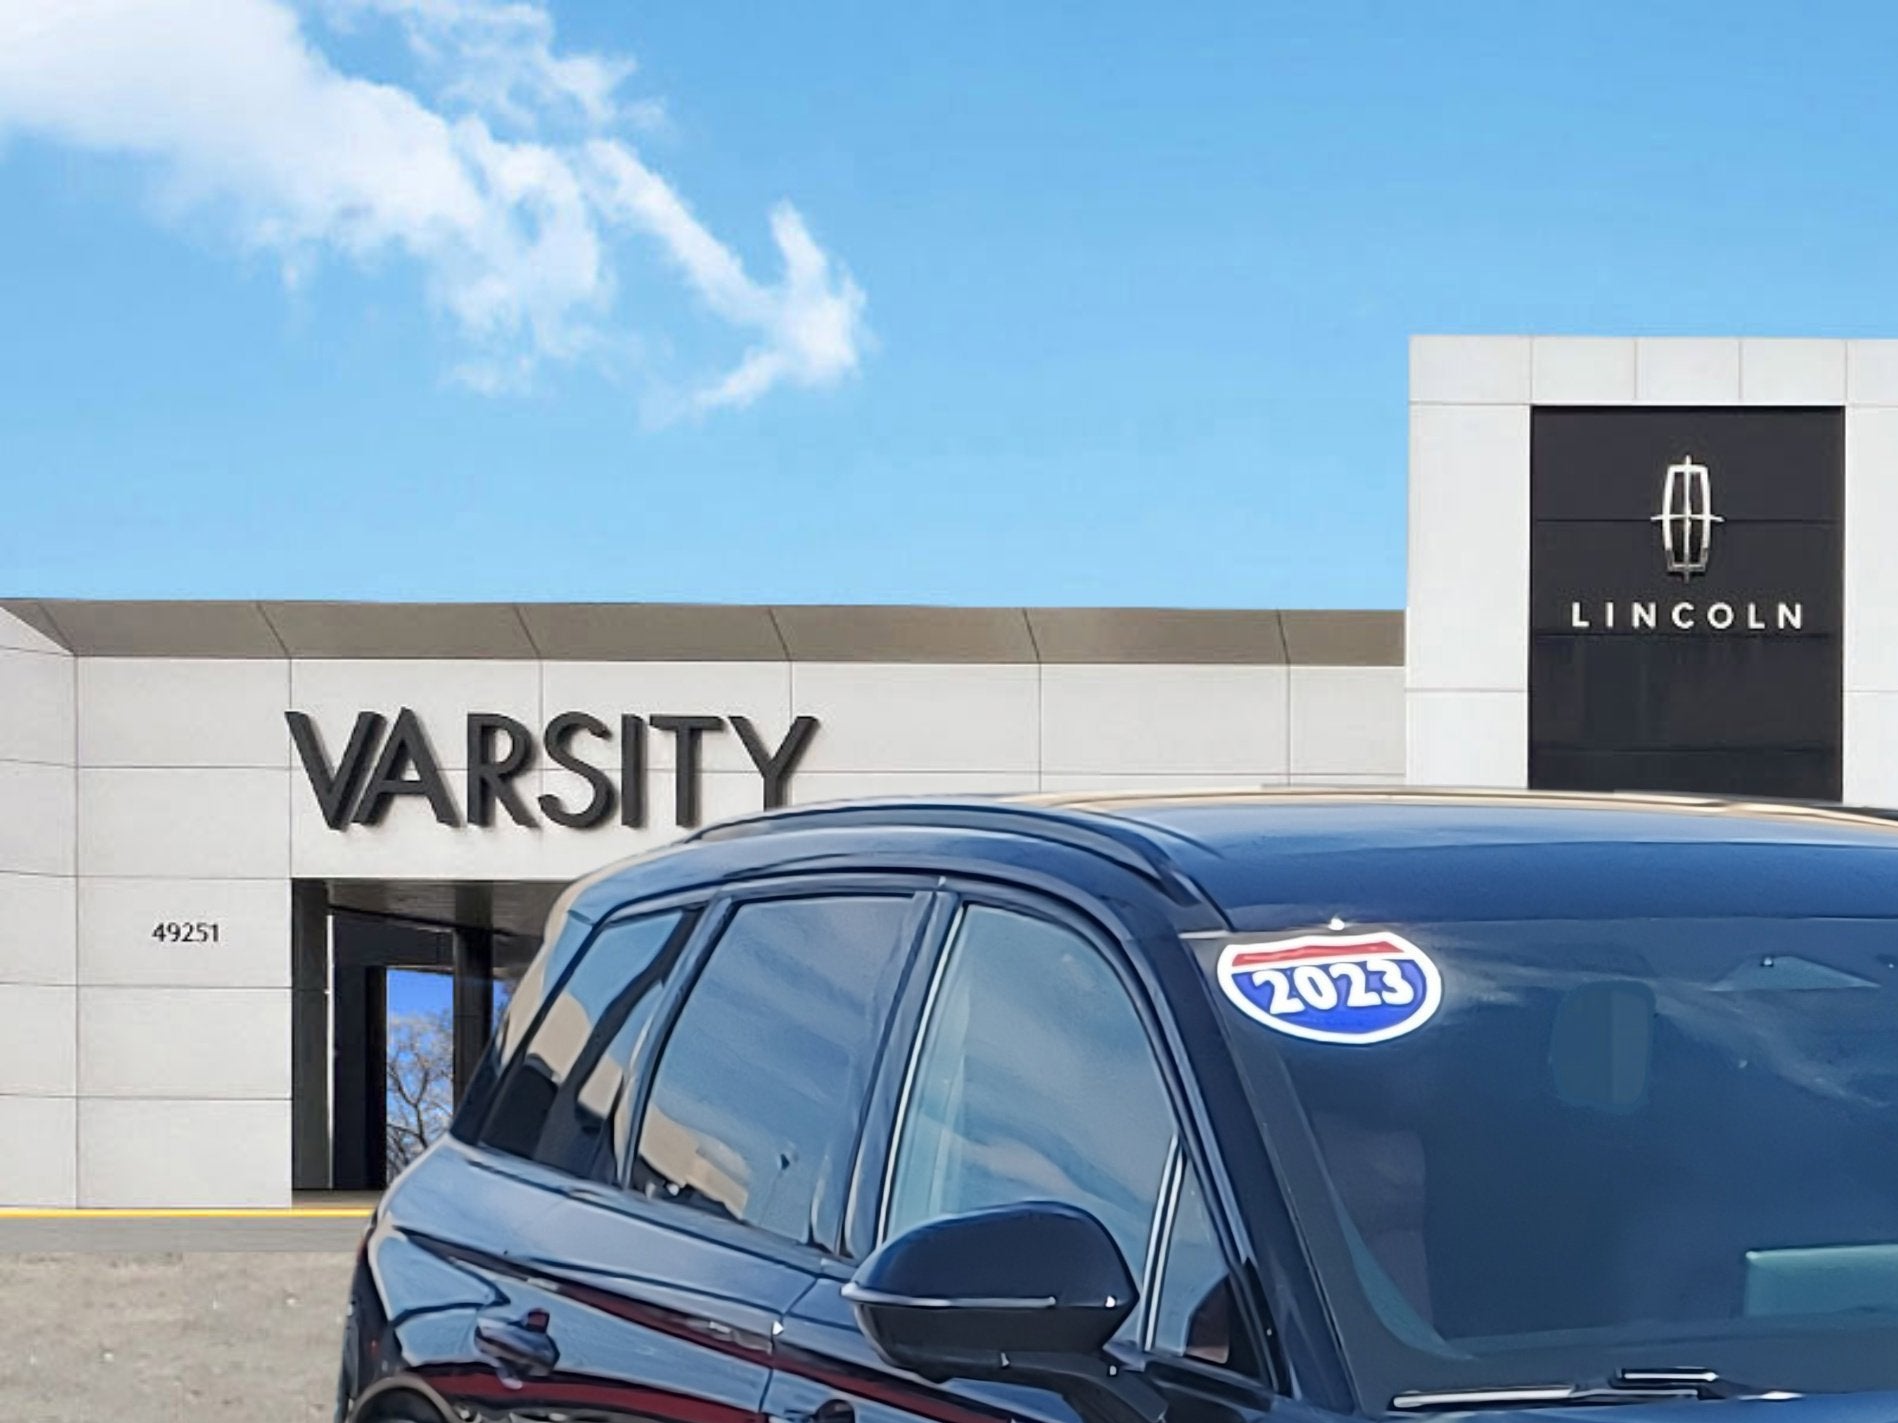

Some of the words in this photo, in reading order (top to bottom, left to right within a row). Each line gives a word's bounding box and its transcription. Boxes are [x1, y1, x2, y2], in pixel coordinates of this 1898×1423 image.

[1571, 602, 1803, 630] LINCOLN
[284, 706, 822, 831] VARSITY
[151, 921, 219, 942] 49251
[1252, 958, 1414, 1015] 2023
